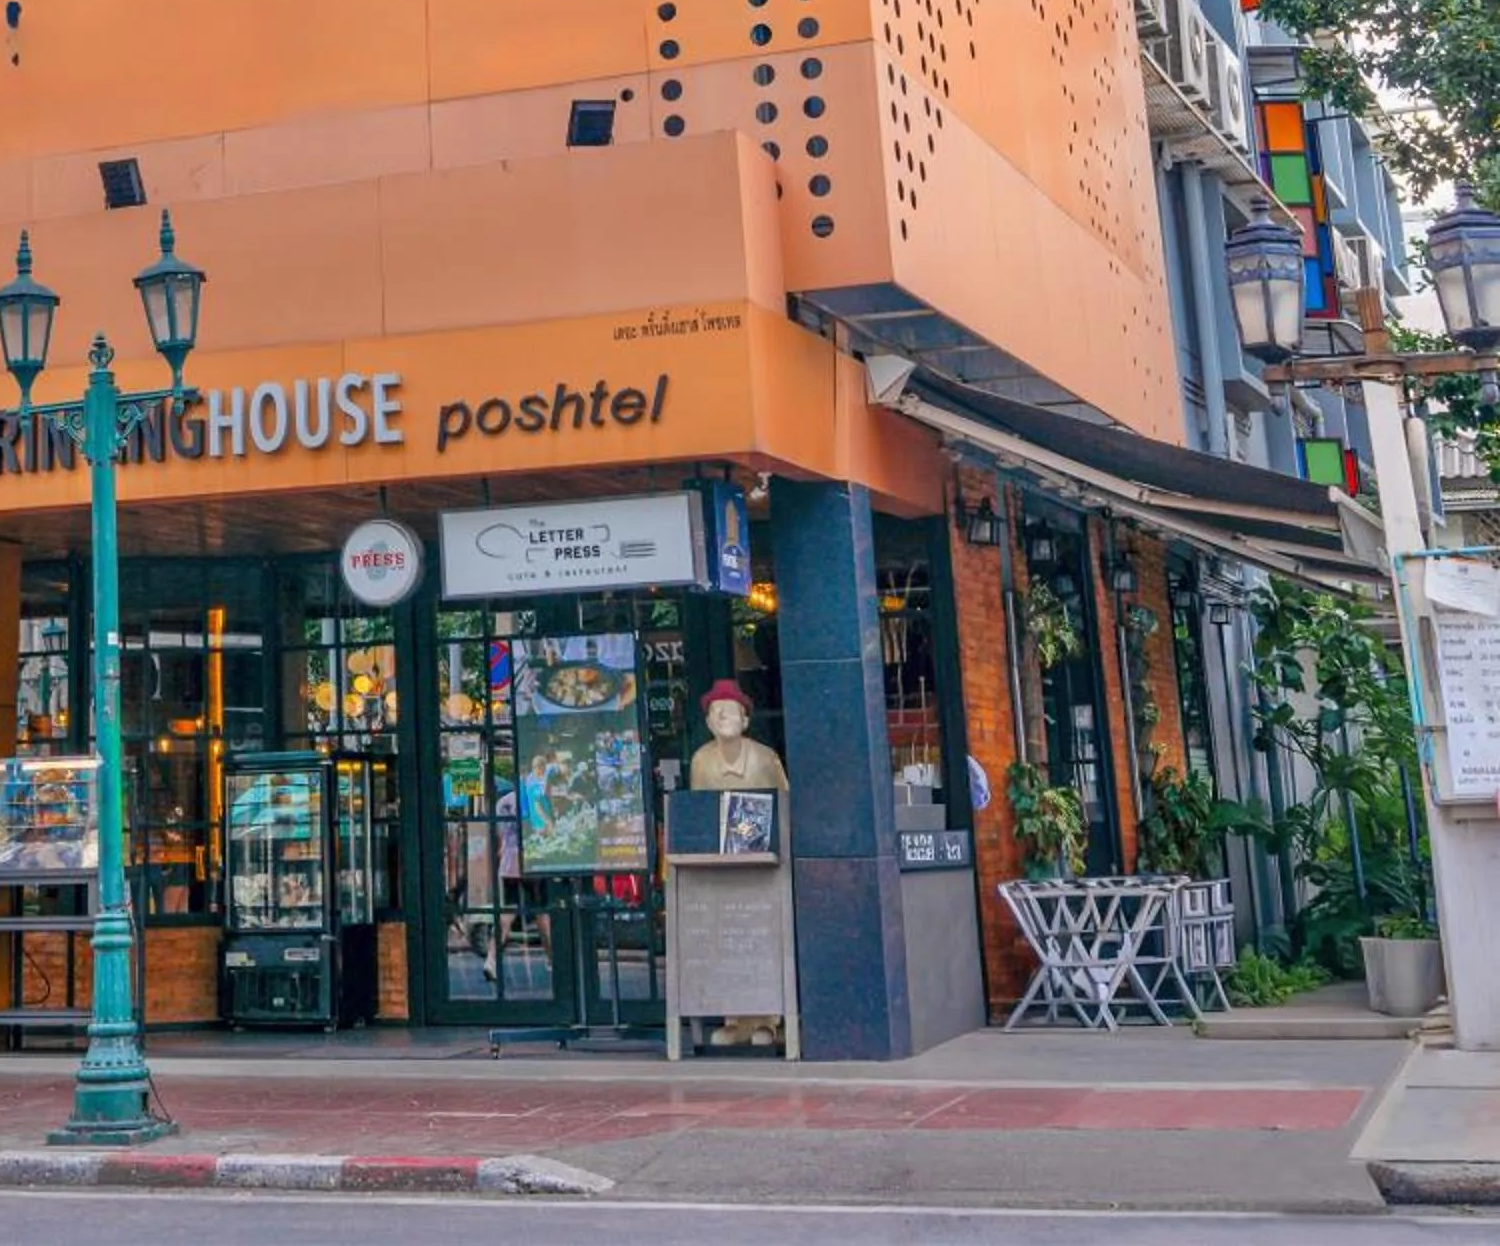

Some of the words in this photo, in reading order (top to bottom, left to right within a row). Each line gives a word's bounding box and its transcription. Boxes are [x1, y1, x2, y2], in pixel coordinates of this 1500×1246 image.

[436, 373, 669, 452] poshtel
[528, 527, 585, 545] LETTER
[350, 551, 405, 570] PRESS
[554, 544, 601, 561] PRESS
